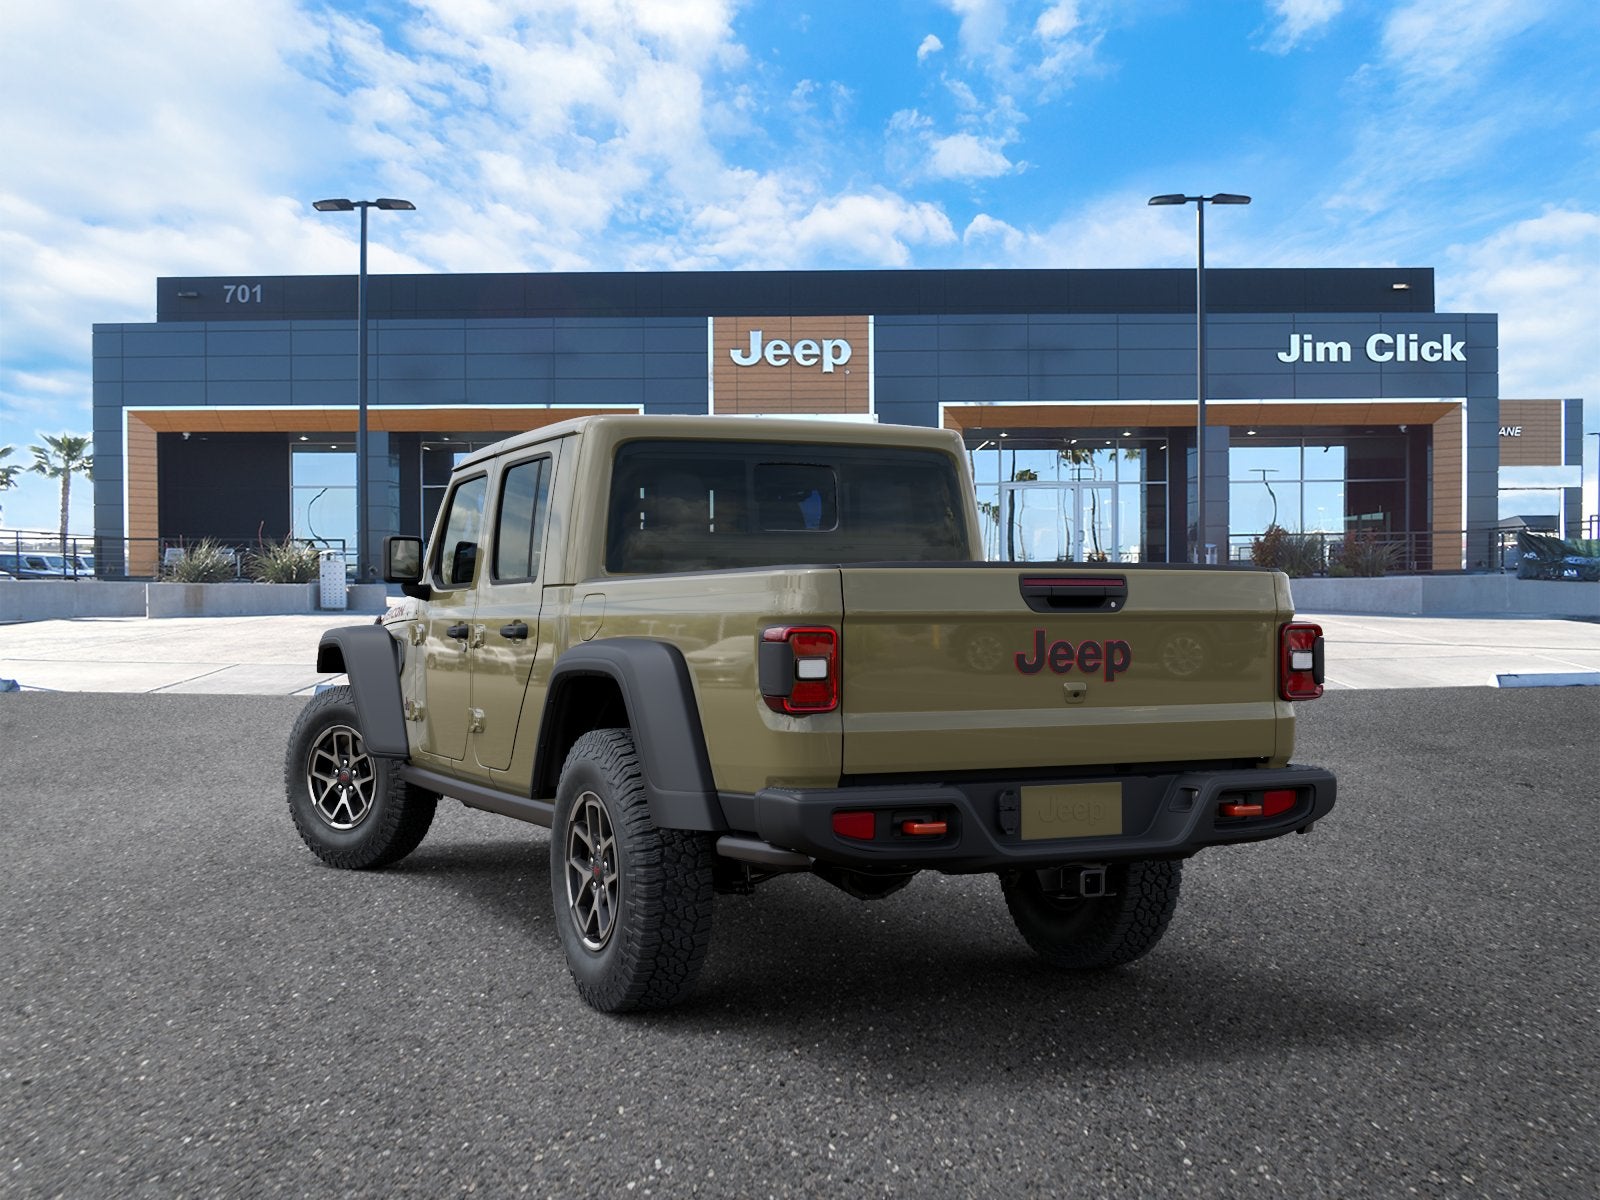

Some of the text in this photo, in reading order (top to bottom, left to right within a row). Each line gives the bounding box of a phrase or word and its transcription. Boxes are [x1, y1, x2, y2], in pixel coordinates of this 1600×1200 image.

[223, 284, 262, 303] 701
[729, 330, 852, 373] Jeep
[1277, 333, 1467, 363] Jim Click
[1014, 627, 1132, 682] Jeep
[1036, 794, 1105, 826] Jeep
